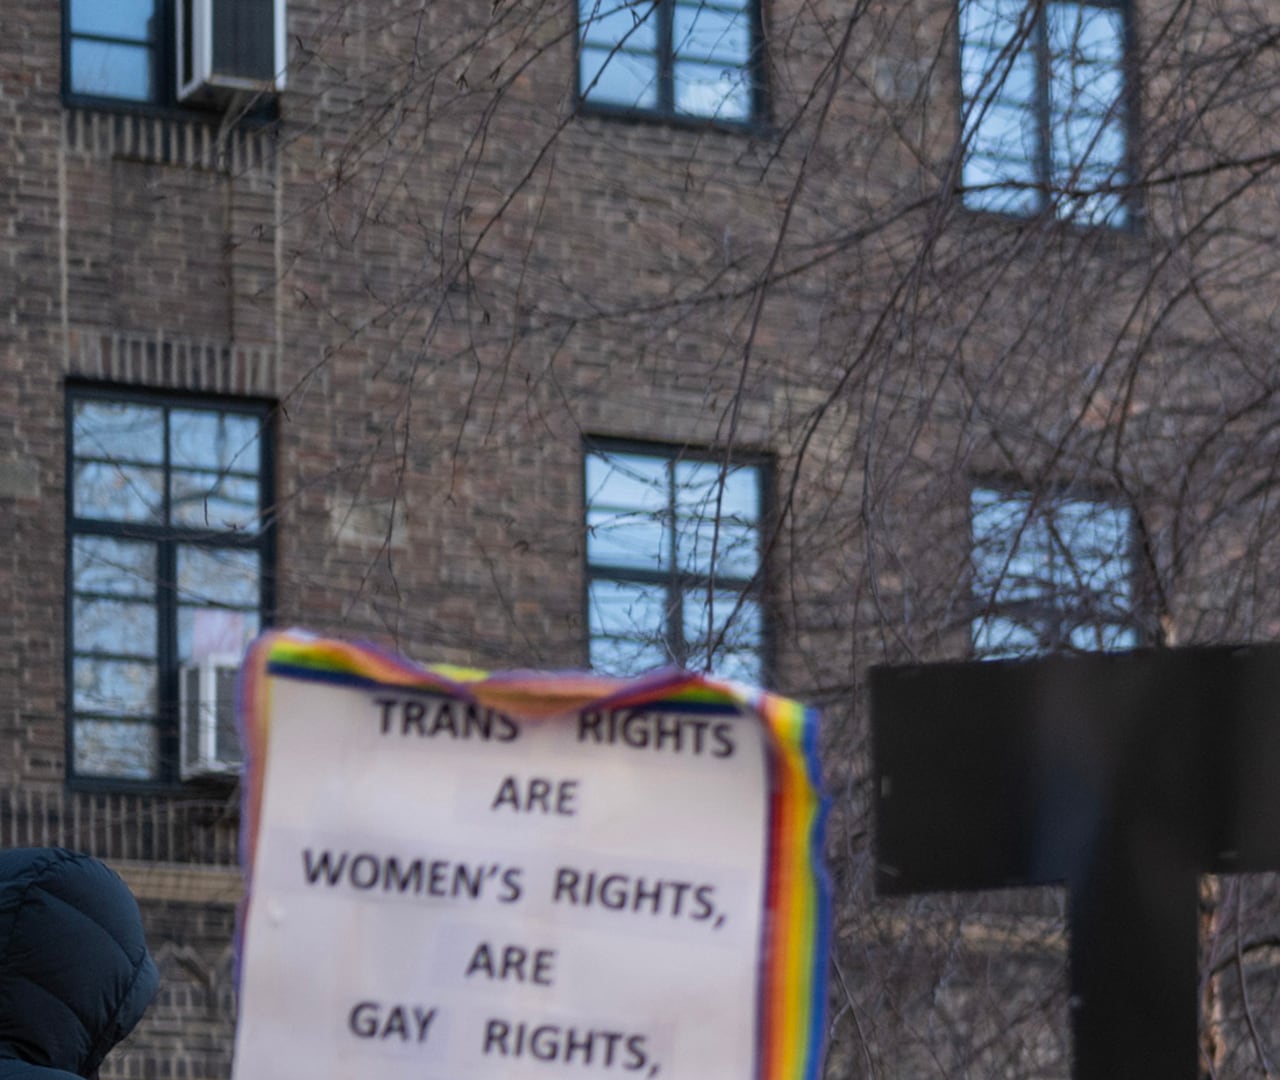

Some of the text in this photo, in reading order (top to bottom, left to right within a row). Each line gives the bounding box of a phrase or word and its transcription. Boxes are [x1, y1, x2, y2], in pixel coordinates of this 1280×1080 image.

[373, 697, 735, 760] TRANS RIGHTS
[490, 775, 580, 817] ARE
[552, 866, 728, 929] RIGHTS,
[465, 941, 557, 987] ARE
[347, 1000, 662, 1079] GAY RIGHTS,
